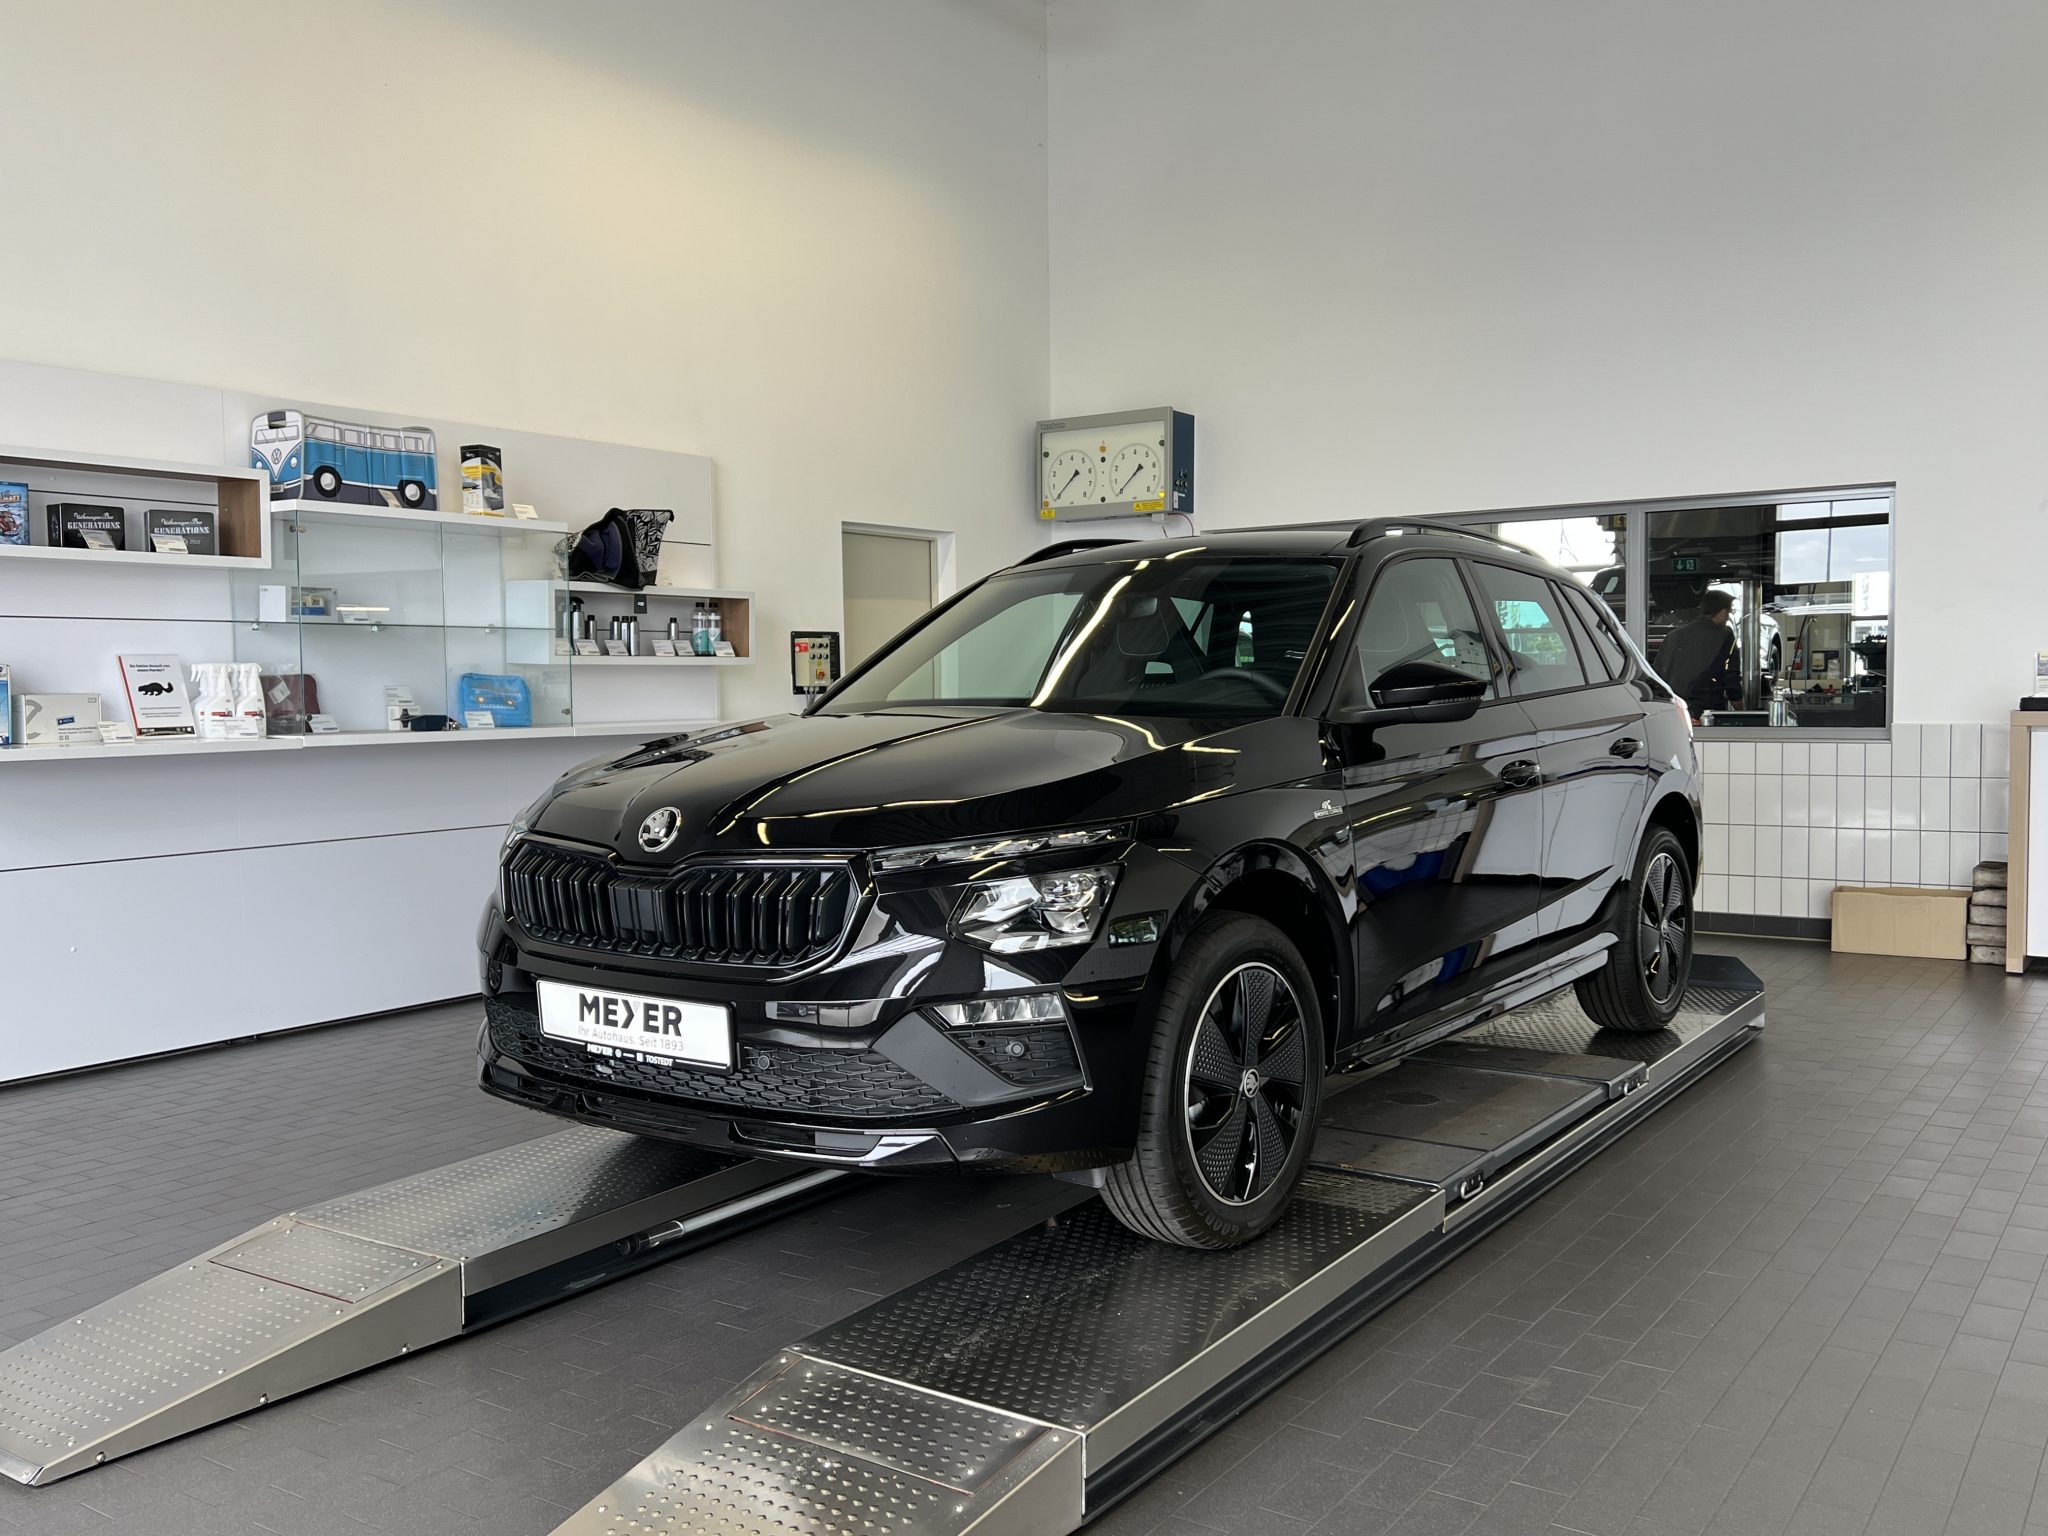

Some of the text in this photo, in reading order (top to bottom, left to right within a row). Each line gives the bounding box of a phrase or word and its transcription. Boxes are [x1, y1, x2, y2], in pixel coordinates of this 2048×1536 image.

[67, 521, 121, 530] GENERATIONS
[154, 526, 210, 534] GENERATIONS
[578, 992, 683, 1037] MEYER
[578, 1025, 684, 1052] Ihr Autohaus. Seit 1893
[586, 1043, 674, 1067] MEYER TOSTEDT
